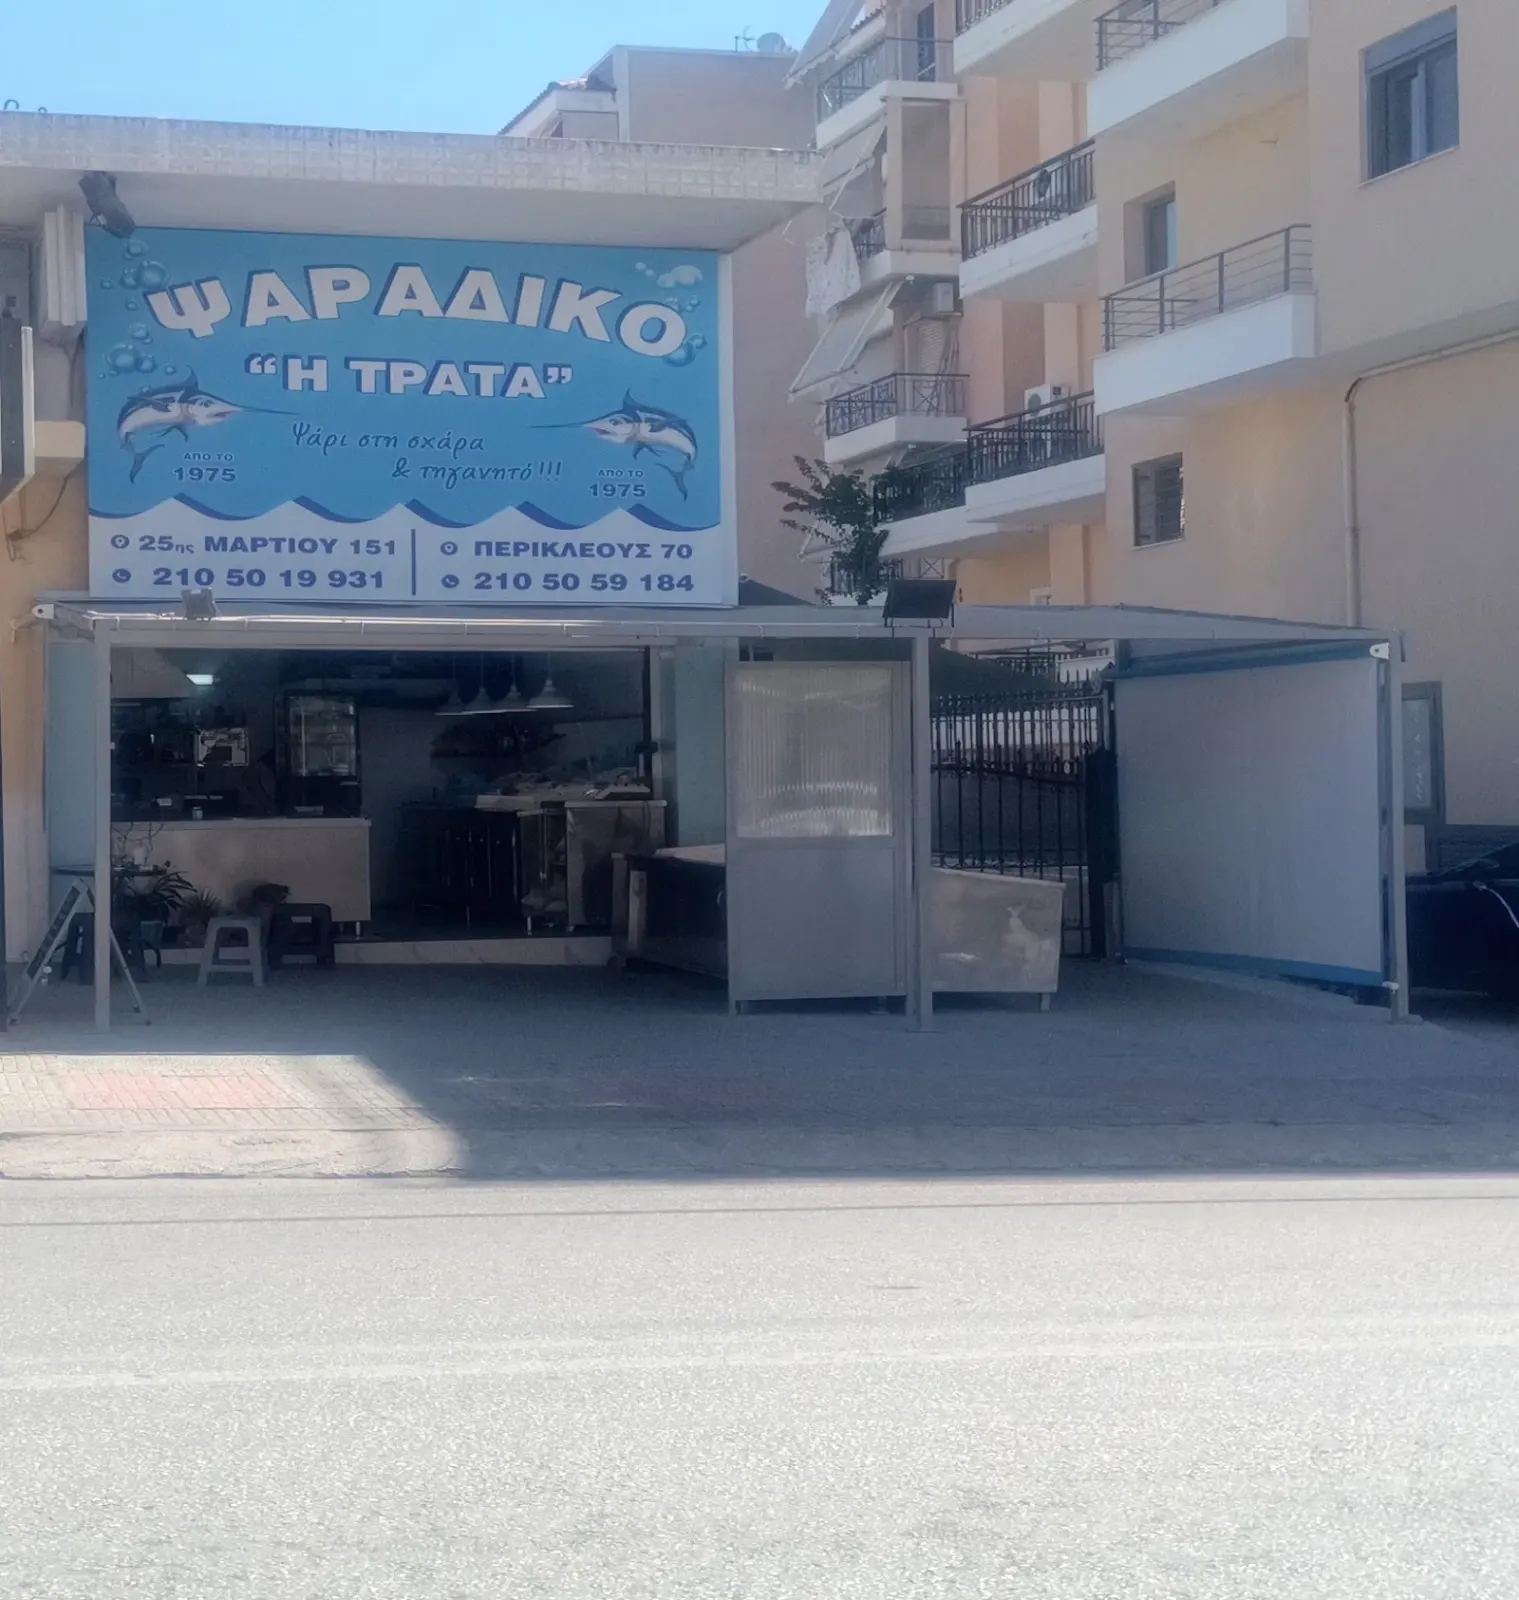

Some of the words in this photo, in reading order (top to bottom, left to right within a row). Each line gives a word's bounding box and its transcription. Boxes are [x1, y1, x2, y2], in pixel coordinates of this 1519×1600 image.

[144, 262, 687, 357] ΨΑΡΑΔΙΚΟ
[292, 421, 349, 456] Ψάρι
[358, 433, 398, 449] στη
[408, 431, 484, 459] σχάρα
[183, 452, 212, 461] ΑΠΟ
[216, 453, 233, 461] ΤΟ
[174, 466, 236, 482] 1975
[391, 457, 411, 479] &
[598, 469, 624, 478] ΑΠΟ
[627, 469, 644, 478] ΤΟ
[589, 483, 646, 497] 1975
[204, 536, 338, 554] ΜΑΡΤΙΟΥ
[349, 538, 395, 555] 151
[474, 540, 652, 559] ΠΕΡΙΚΛΕΟΥΣ
[660, 543, 693, 559] 70
[153, 568, 215, 586] 210
[226, 568, 266, 587] 50
[279, 569, 317, 587] 19
[327, 570, 383, 588] 931
[474, 572, 532, 590] 210
[542, 573, 580, 591] 50
[590, 574, 628, 591] 59
[640, 574, 694, 592] 184
